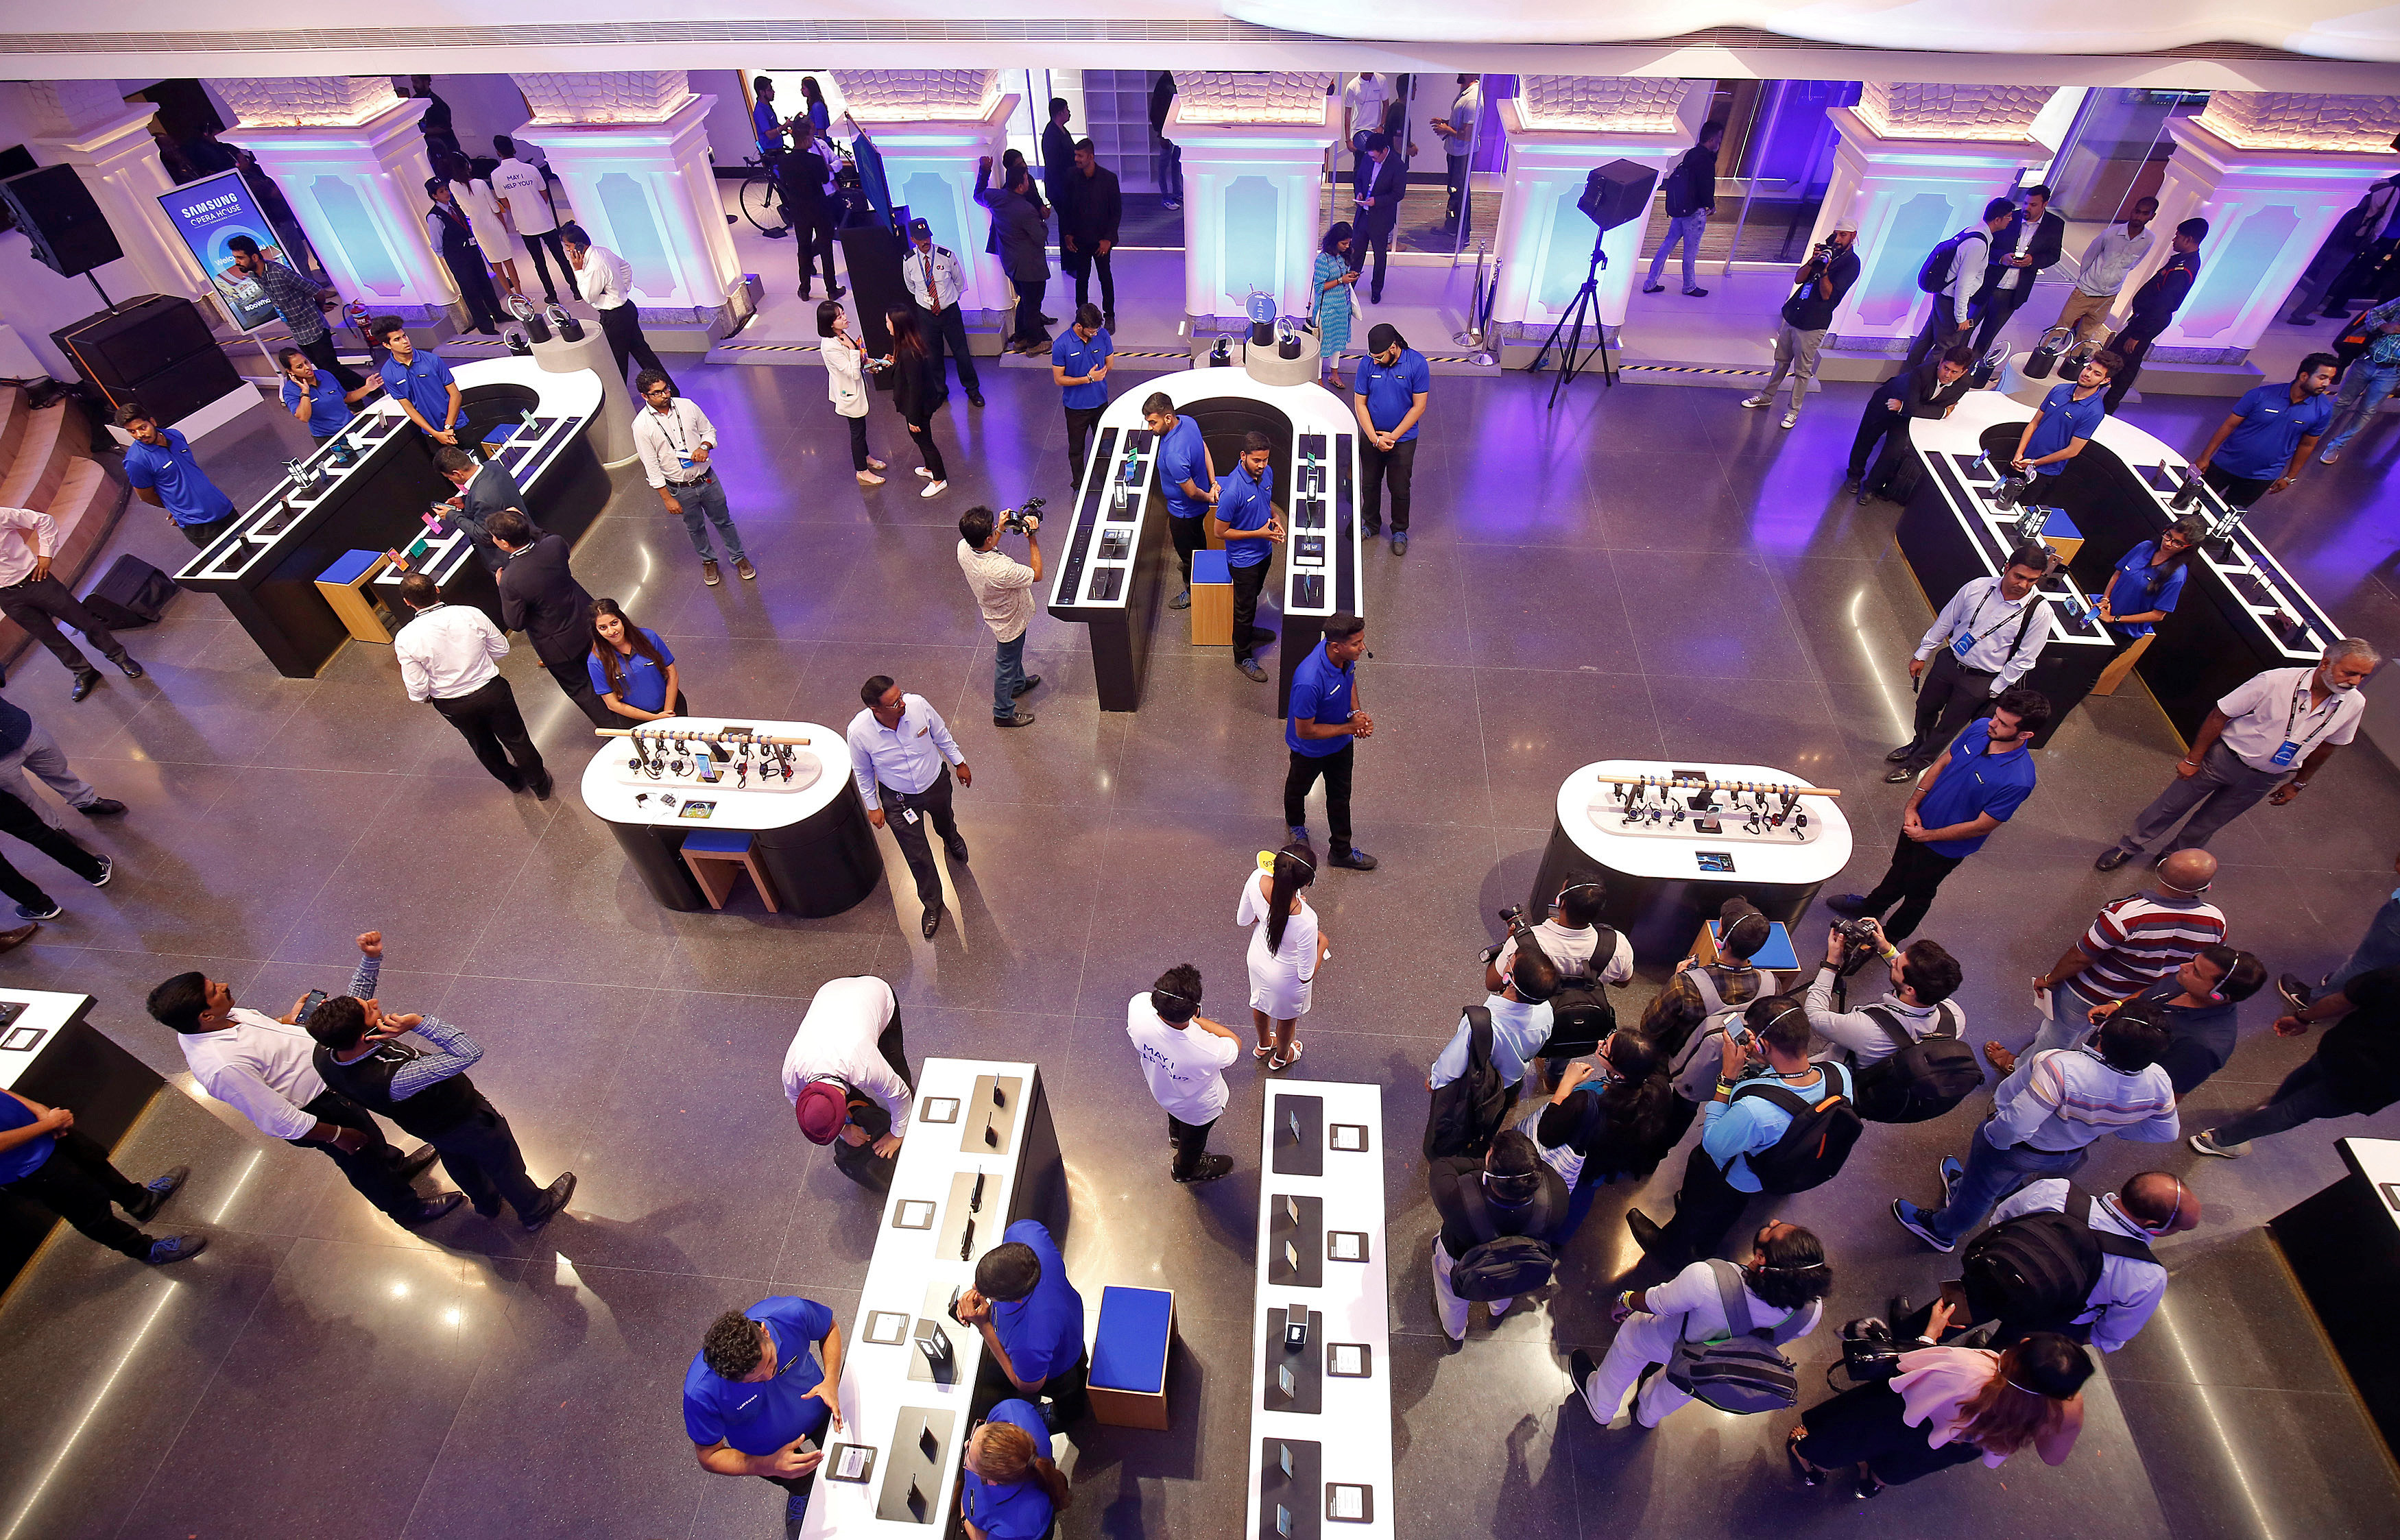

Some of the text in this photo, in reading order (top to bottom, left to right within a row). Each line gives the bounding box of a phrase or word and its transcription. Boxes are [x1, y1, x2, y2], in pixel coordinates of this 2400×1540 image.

[181, 193, 238, 219] SAMSUNG
[190, 204, 242, 226] OPERA HOUSE
[1143, 1043, 1168, 1063] MAY
